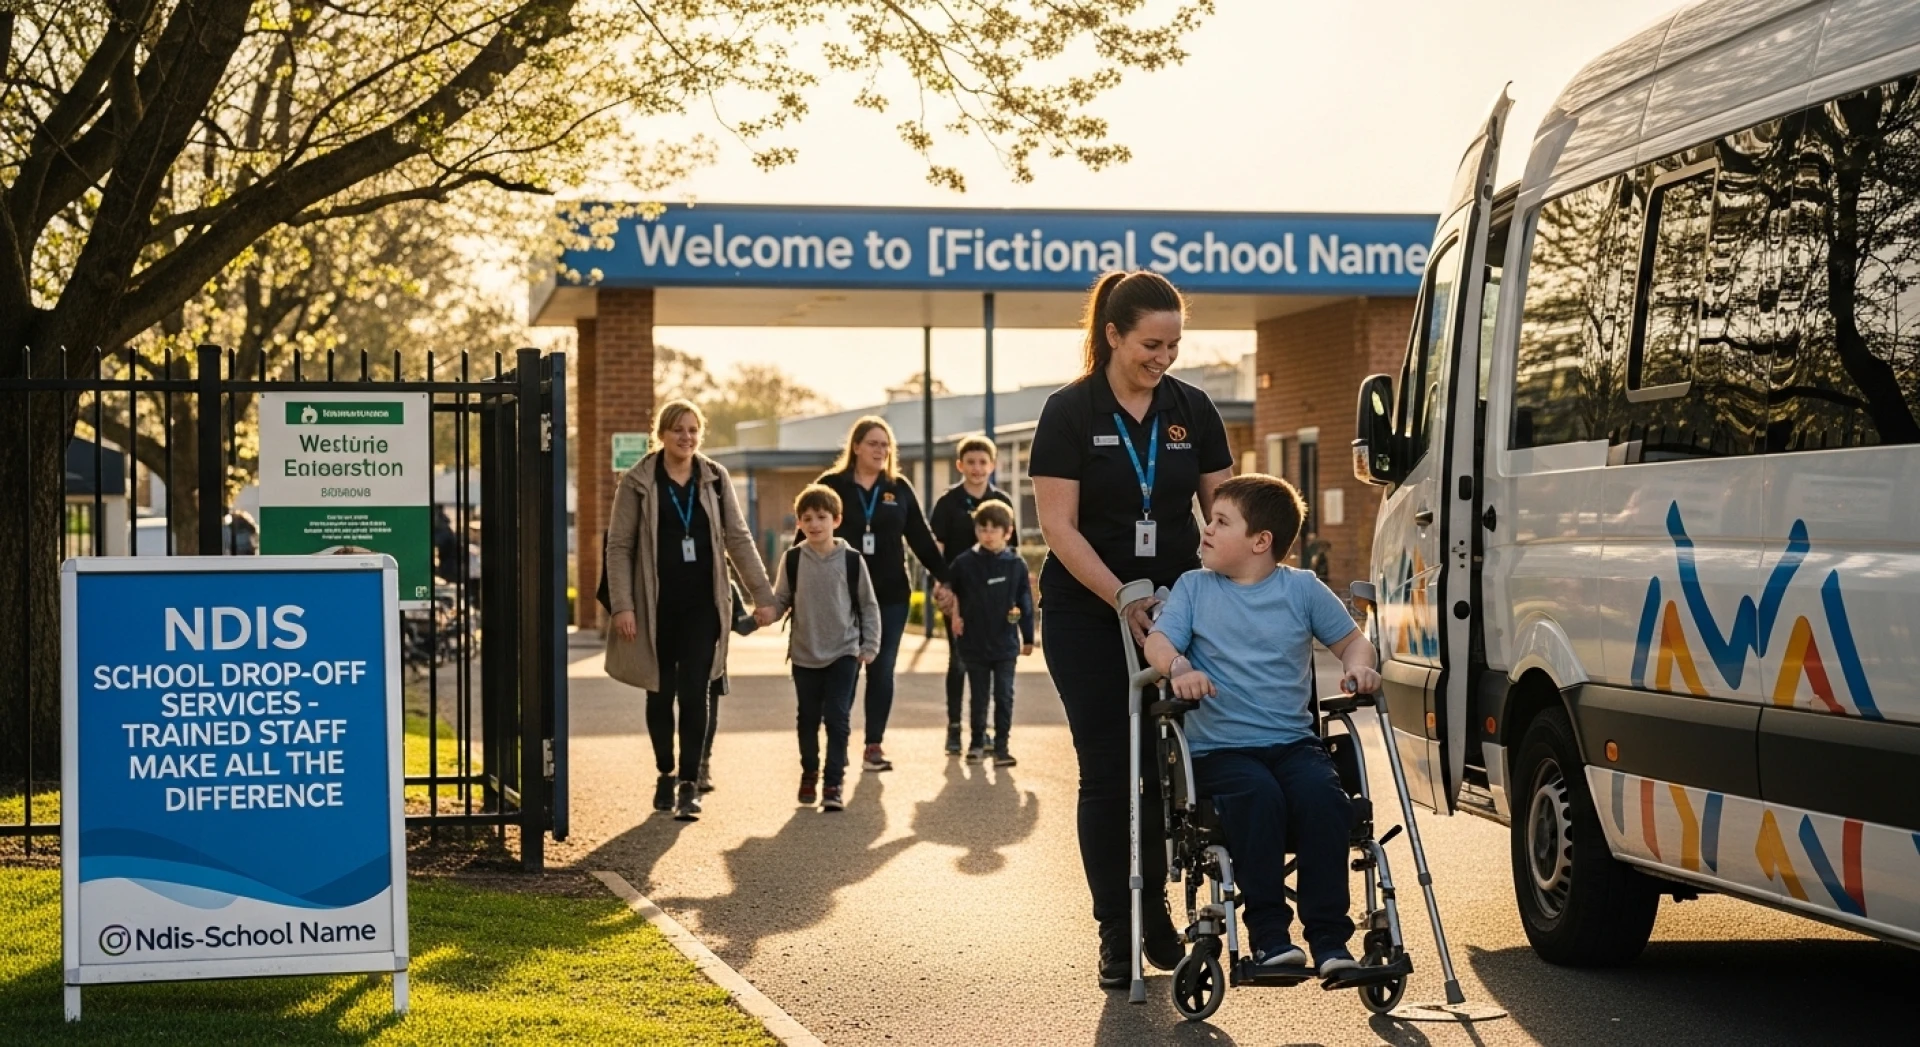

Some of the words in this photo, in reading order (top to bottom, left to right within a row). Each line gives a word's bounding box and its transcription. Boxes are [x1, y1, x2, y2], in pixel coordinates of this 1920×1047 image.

[636, 224, 853, 269] Welcome
[864, 230, 912, 269] to
[928, 227, 1139, 276] [Fictional
[1150, 231, 1298, 275] School
[1308, 233, 1426, 275] Name
[165, 605, 308, 651] NDIS
[93, 664, 214, 690] SCHOOL
[221, 661, 366, 687] DROP-OFF
[161, 691, 301, 717] SERVICES
[122, 721, 251, 748] TRAINED
[259, 719, 347, 745] STAFF
[129, 753, 217, 779] MAKE
[224, 751, 280, 776] ALL
[286, 750, 345, 775] THE
[165, 782, 343, 811] DIFFERENCE
[136, 922, 293, 951] Ndis-School
[300, 921, 376, 943] Name
